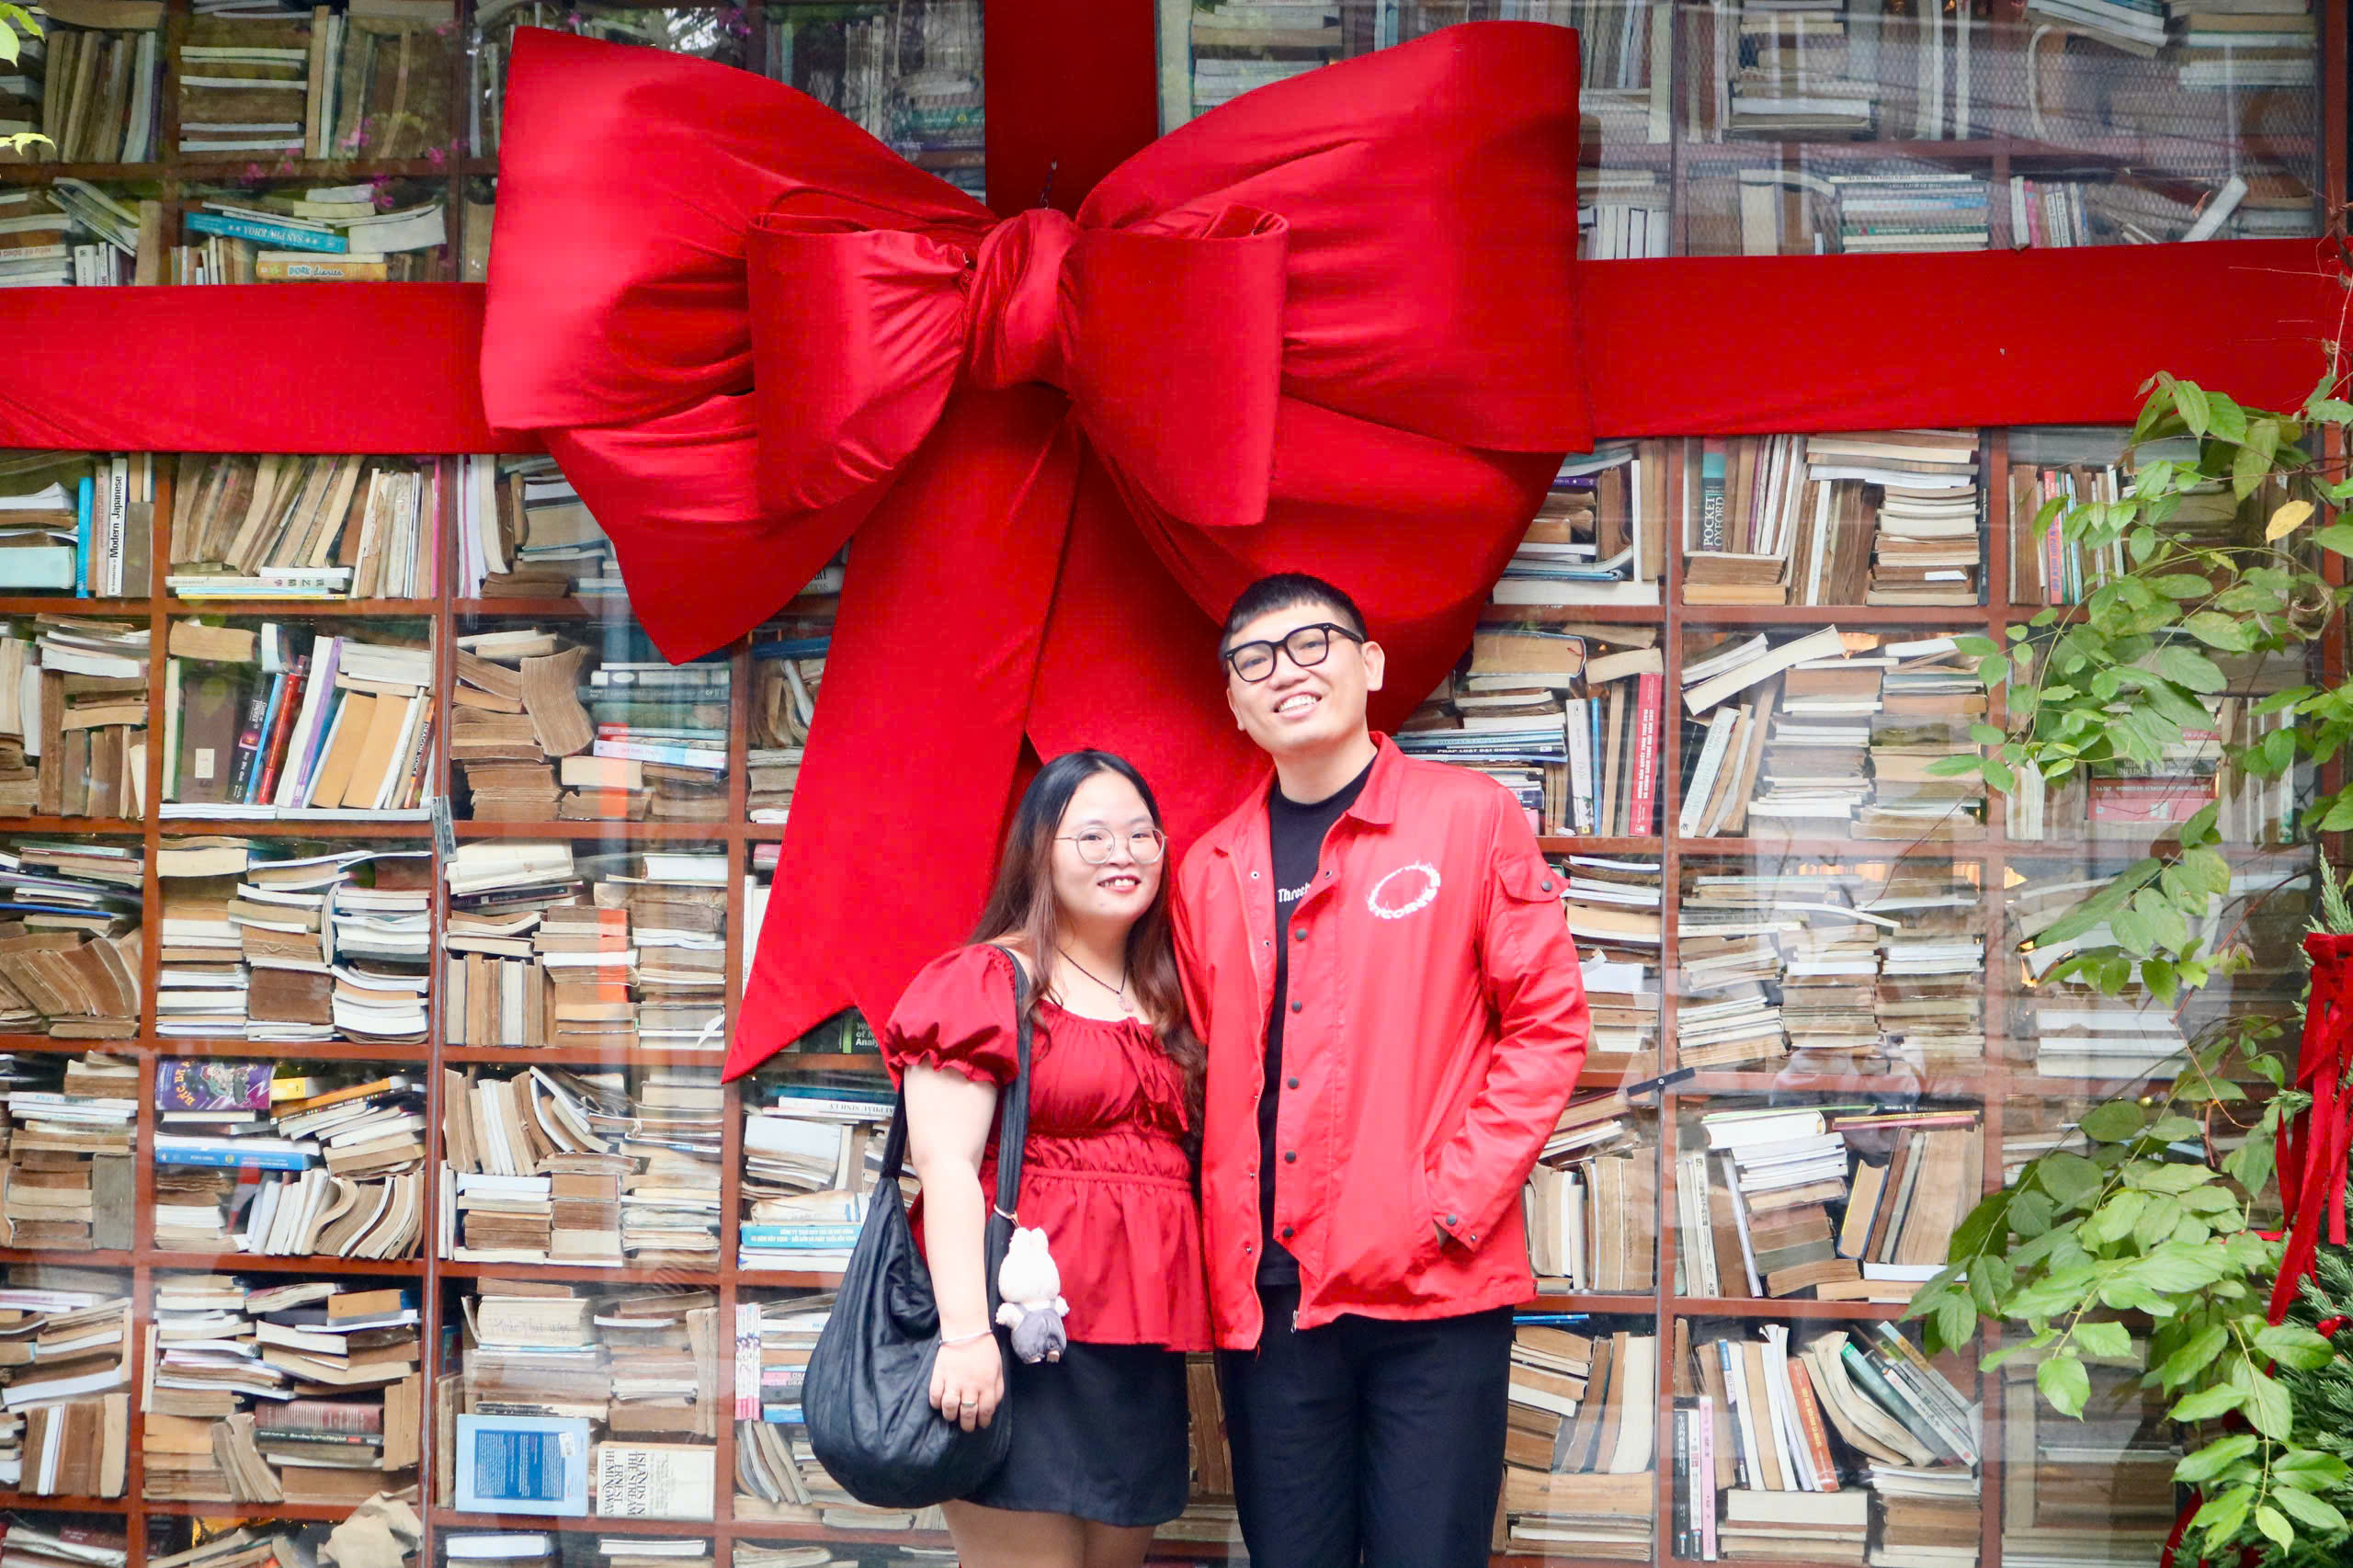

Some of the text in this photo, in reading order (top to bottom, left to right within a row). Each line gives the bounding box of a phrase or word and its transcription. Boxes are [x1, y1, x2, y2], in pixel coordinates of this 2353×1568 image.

[111, 475, 122, 519] Japanese
[1703, 495, 1724, 547] POCKET OXFORD
[109, 522, 120, 559] Modern
[411, 722, 429, 777] DRAGON VOICE
[856, 1038, 879, 1048] Analy
[602, 1450, 615, 1517] HEMINGWAY
[614, 1464, 623, 1505] ERNEST
[627, 1452, 637, 1516] THE STREAM
[636, 1453, 648, 1516] ISLANDS IN
